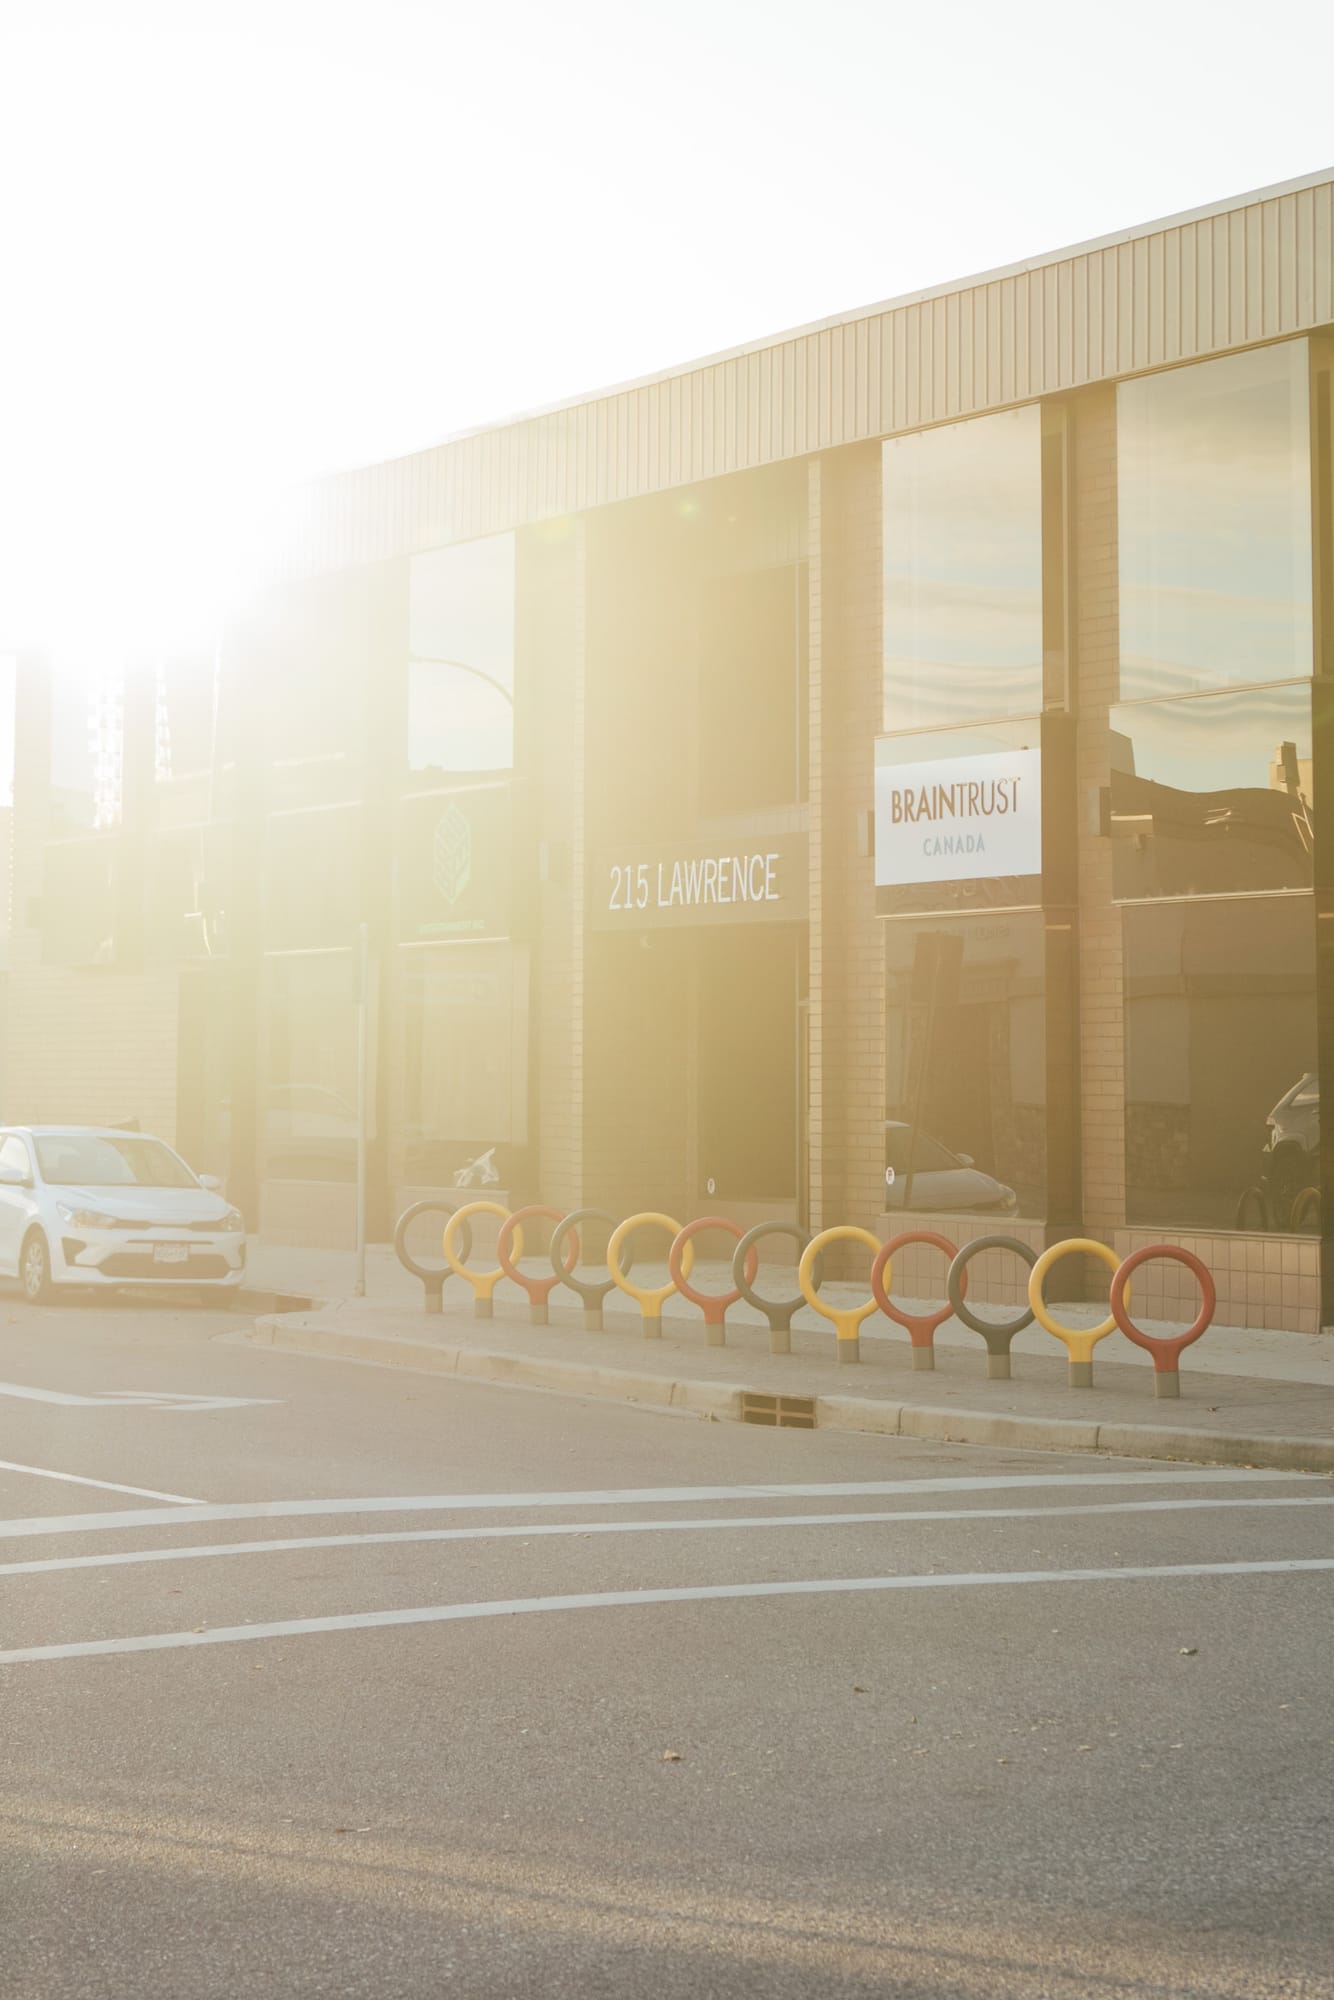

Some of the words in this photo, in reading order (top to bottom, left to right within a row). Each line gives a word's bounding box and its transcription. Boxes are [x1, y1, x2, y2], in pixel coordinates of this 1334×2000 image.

[892, 777, 1020, 823] BRAINTRUST
[923, 834, 985, 857] CANADA
[608, 865, 649, 910] 215
[657, 853, 780, 907] LAWRENCE
